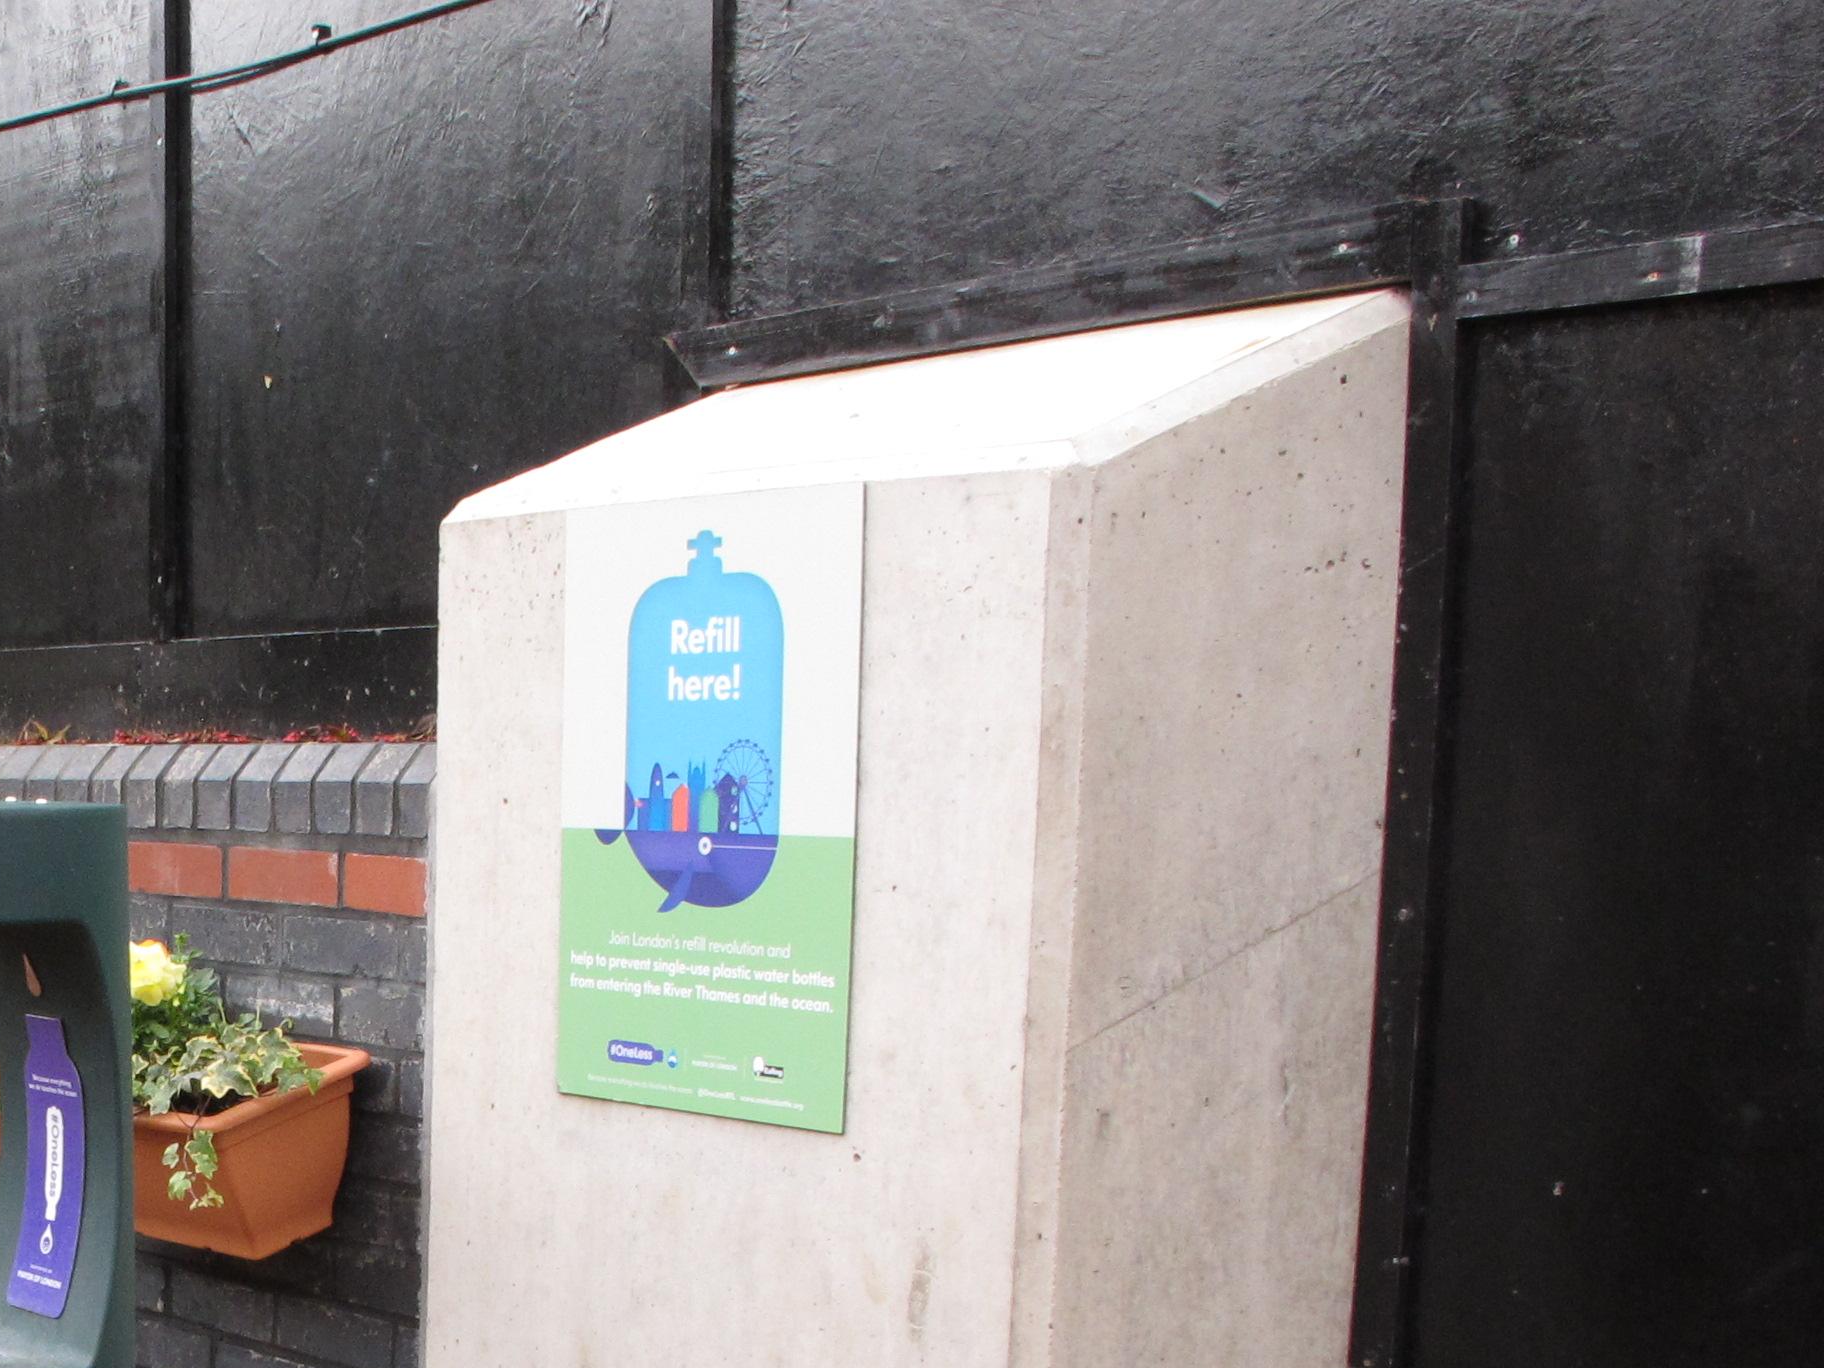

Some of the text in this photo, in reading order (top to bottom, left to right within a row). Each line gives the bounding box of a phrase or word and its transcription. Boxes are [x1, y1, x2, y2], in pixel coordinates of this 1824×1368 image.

[670, 616, 740, 654] Refill
[667, 663, 741, 701] here!
[608, 930, 791, 959] Join London's refill revolution and
[570, 949, 836, 989] help to prevent single-use plastic water bottles
[570, 972, 834, 1014] from entering the River Thames and the ocean.
[609, 1043, 654, 1061] #OneLess
[49, 1113, 60, 1198] #OneLess
